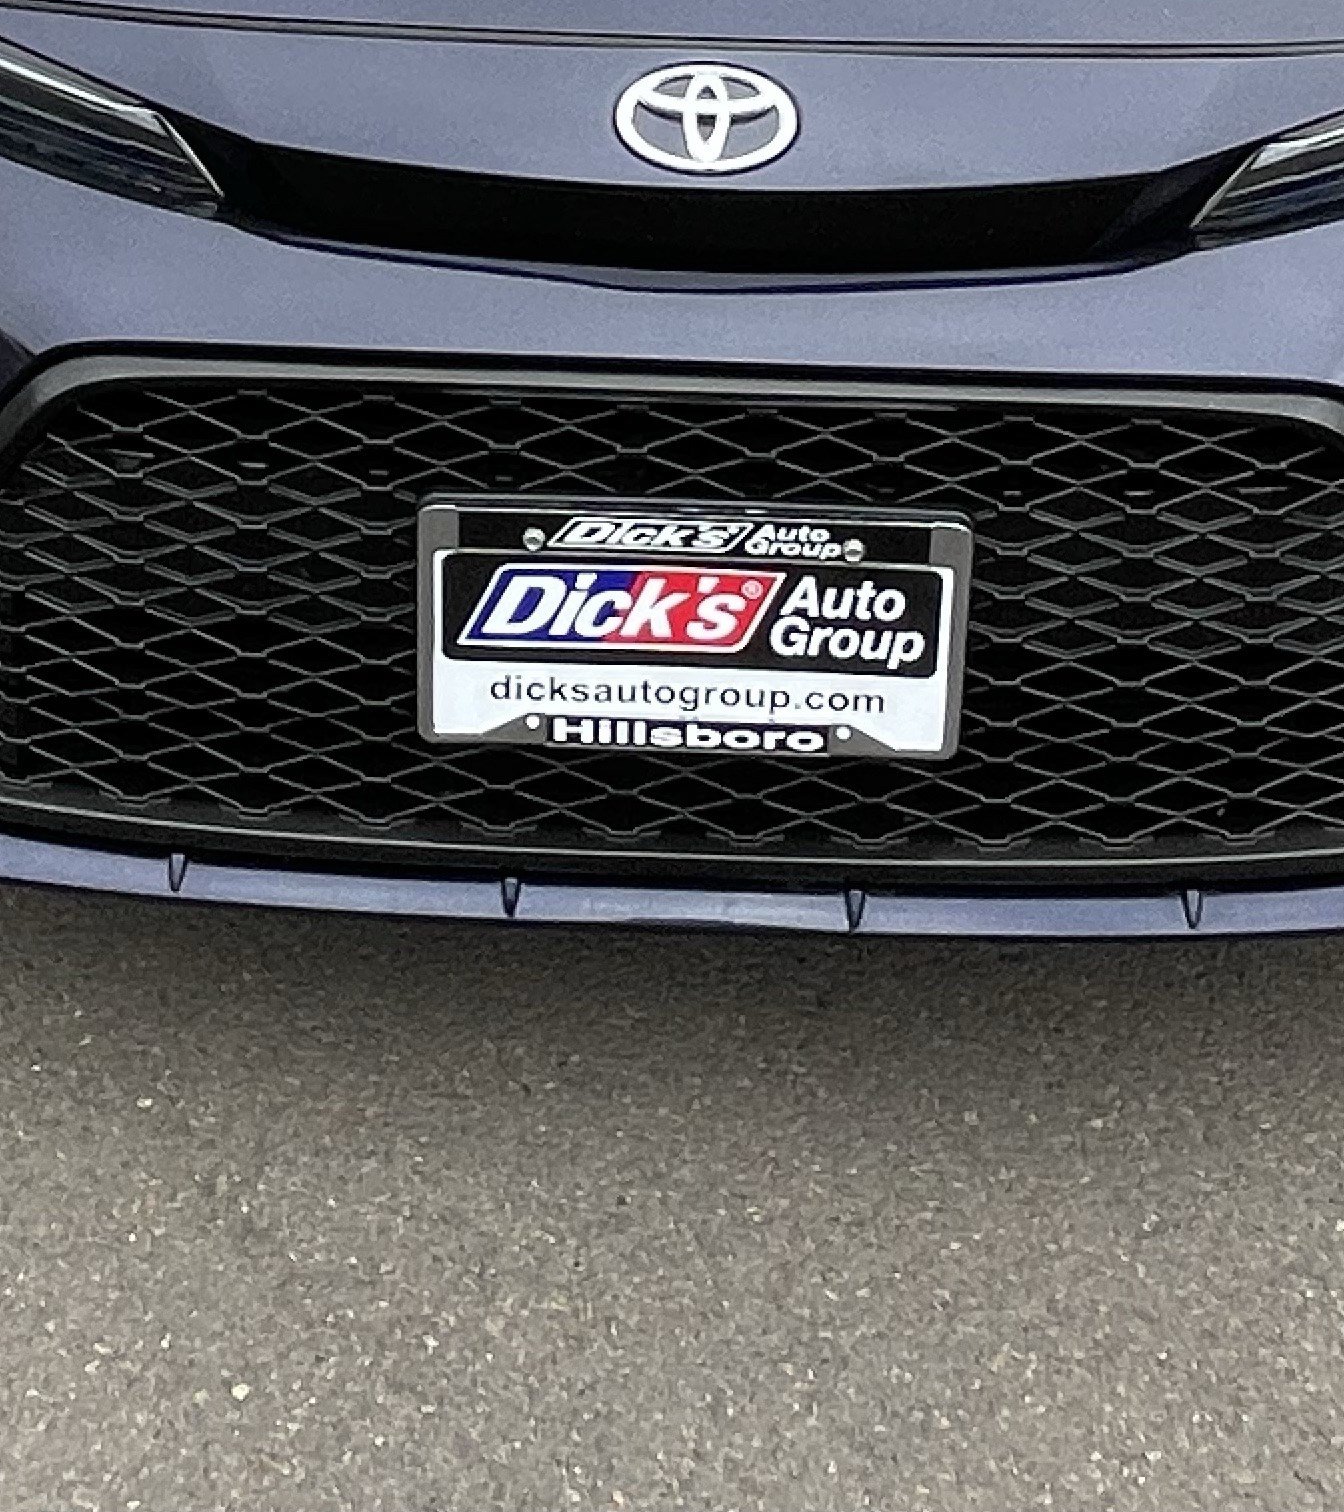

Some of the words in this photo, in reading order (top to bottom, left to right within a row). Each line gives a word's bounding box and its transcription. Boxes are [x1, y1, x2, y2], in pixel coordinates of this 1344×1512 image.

[745, 540, 842, 560] Group
[753, 524, 831, 542] Auto
[481, 572, 747, 640] Dick's
[780, 575, 906, 622] Auto
[770, 618, 926, 670] Group
[490, 674, 886, 714] dicksautogroup.com
[552, 716, 826, 752] Hillsboro
